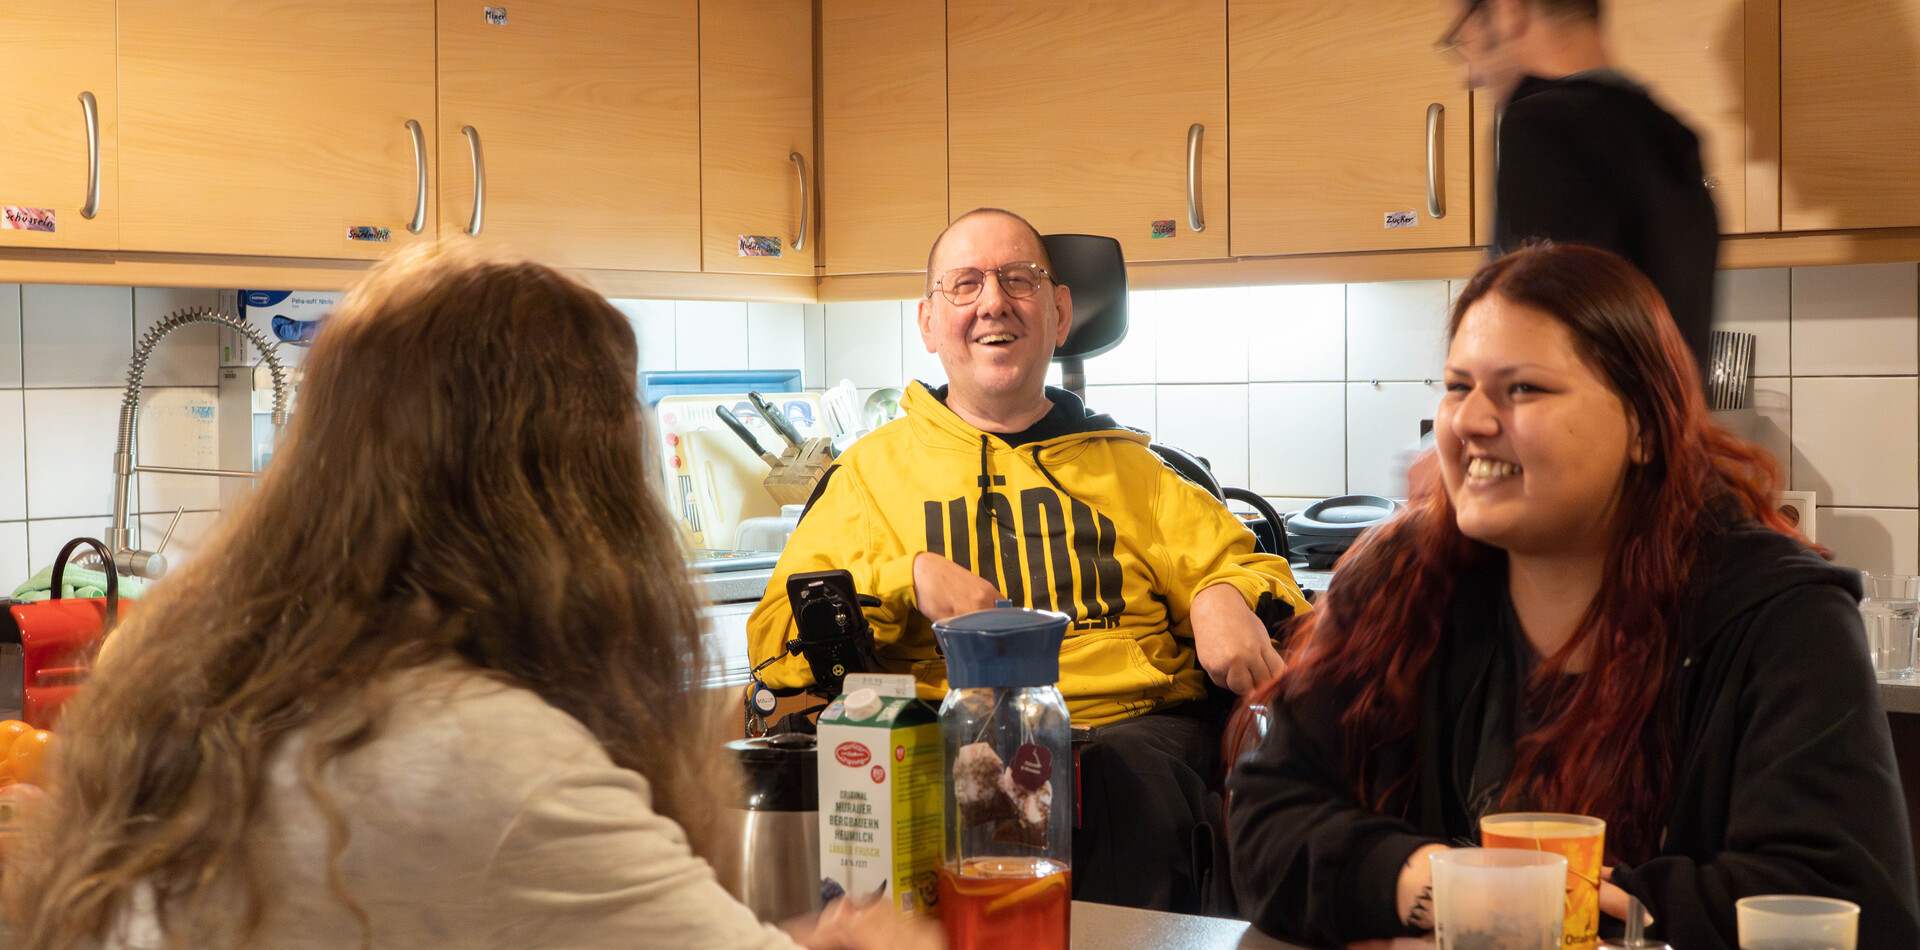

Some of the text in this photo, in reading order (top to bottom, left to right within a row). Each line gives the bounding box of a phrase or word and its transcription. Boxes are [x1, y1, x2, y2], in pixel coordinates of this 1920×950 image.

[485, 10, 505, 20] Mixer
[5, 209, 53, 228] Schüsseln
[840, 790, 867, 801] ORIGINAL
[835, 802, 872, 815] MURAUER
[829, 815, 879, 829] BERGBAUERN
[834, 829, 874, 843] HEUMILCH
[854, 846, 880, 857] FRISCH
